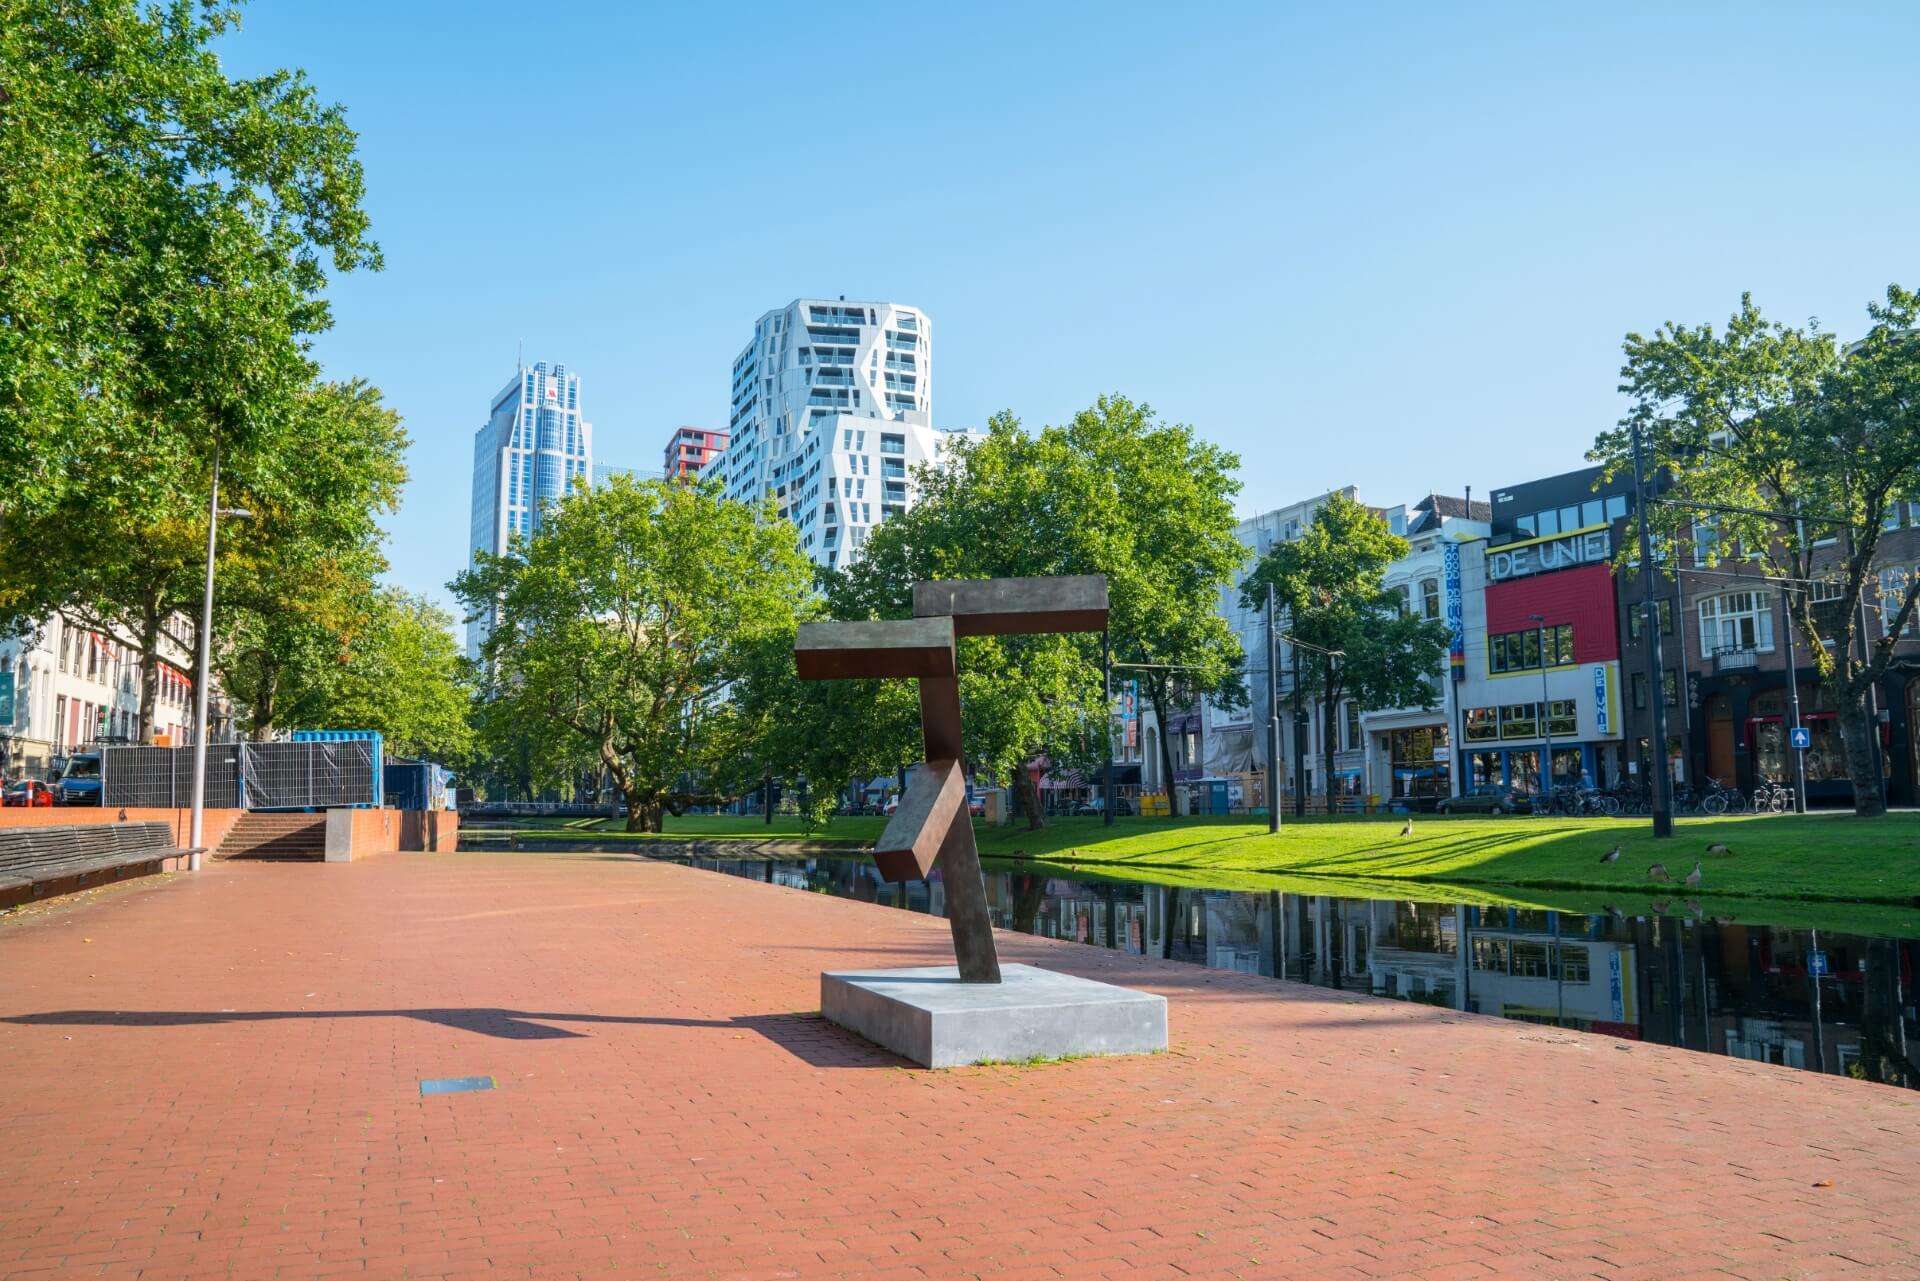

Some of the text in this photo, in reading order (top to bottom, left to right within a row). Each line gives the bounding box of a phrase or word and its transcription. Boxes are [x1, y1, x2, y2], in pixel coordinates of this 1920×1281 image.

[1495, 547, 1530, 578] DE
[1539, 531, 1605, 570] UNIE
[1451, 543, 1463, 642] FOOD DRINKS
[1595, 668, 1607, 733] DE UNIE
